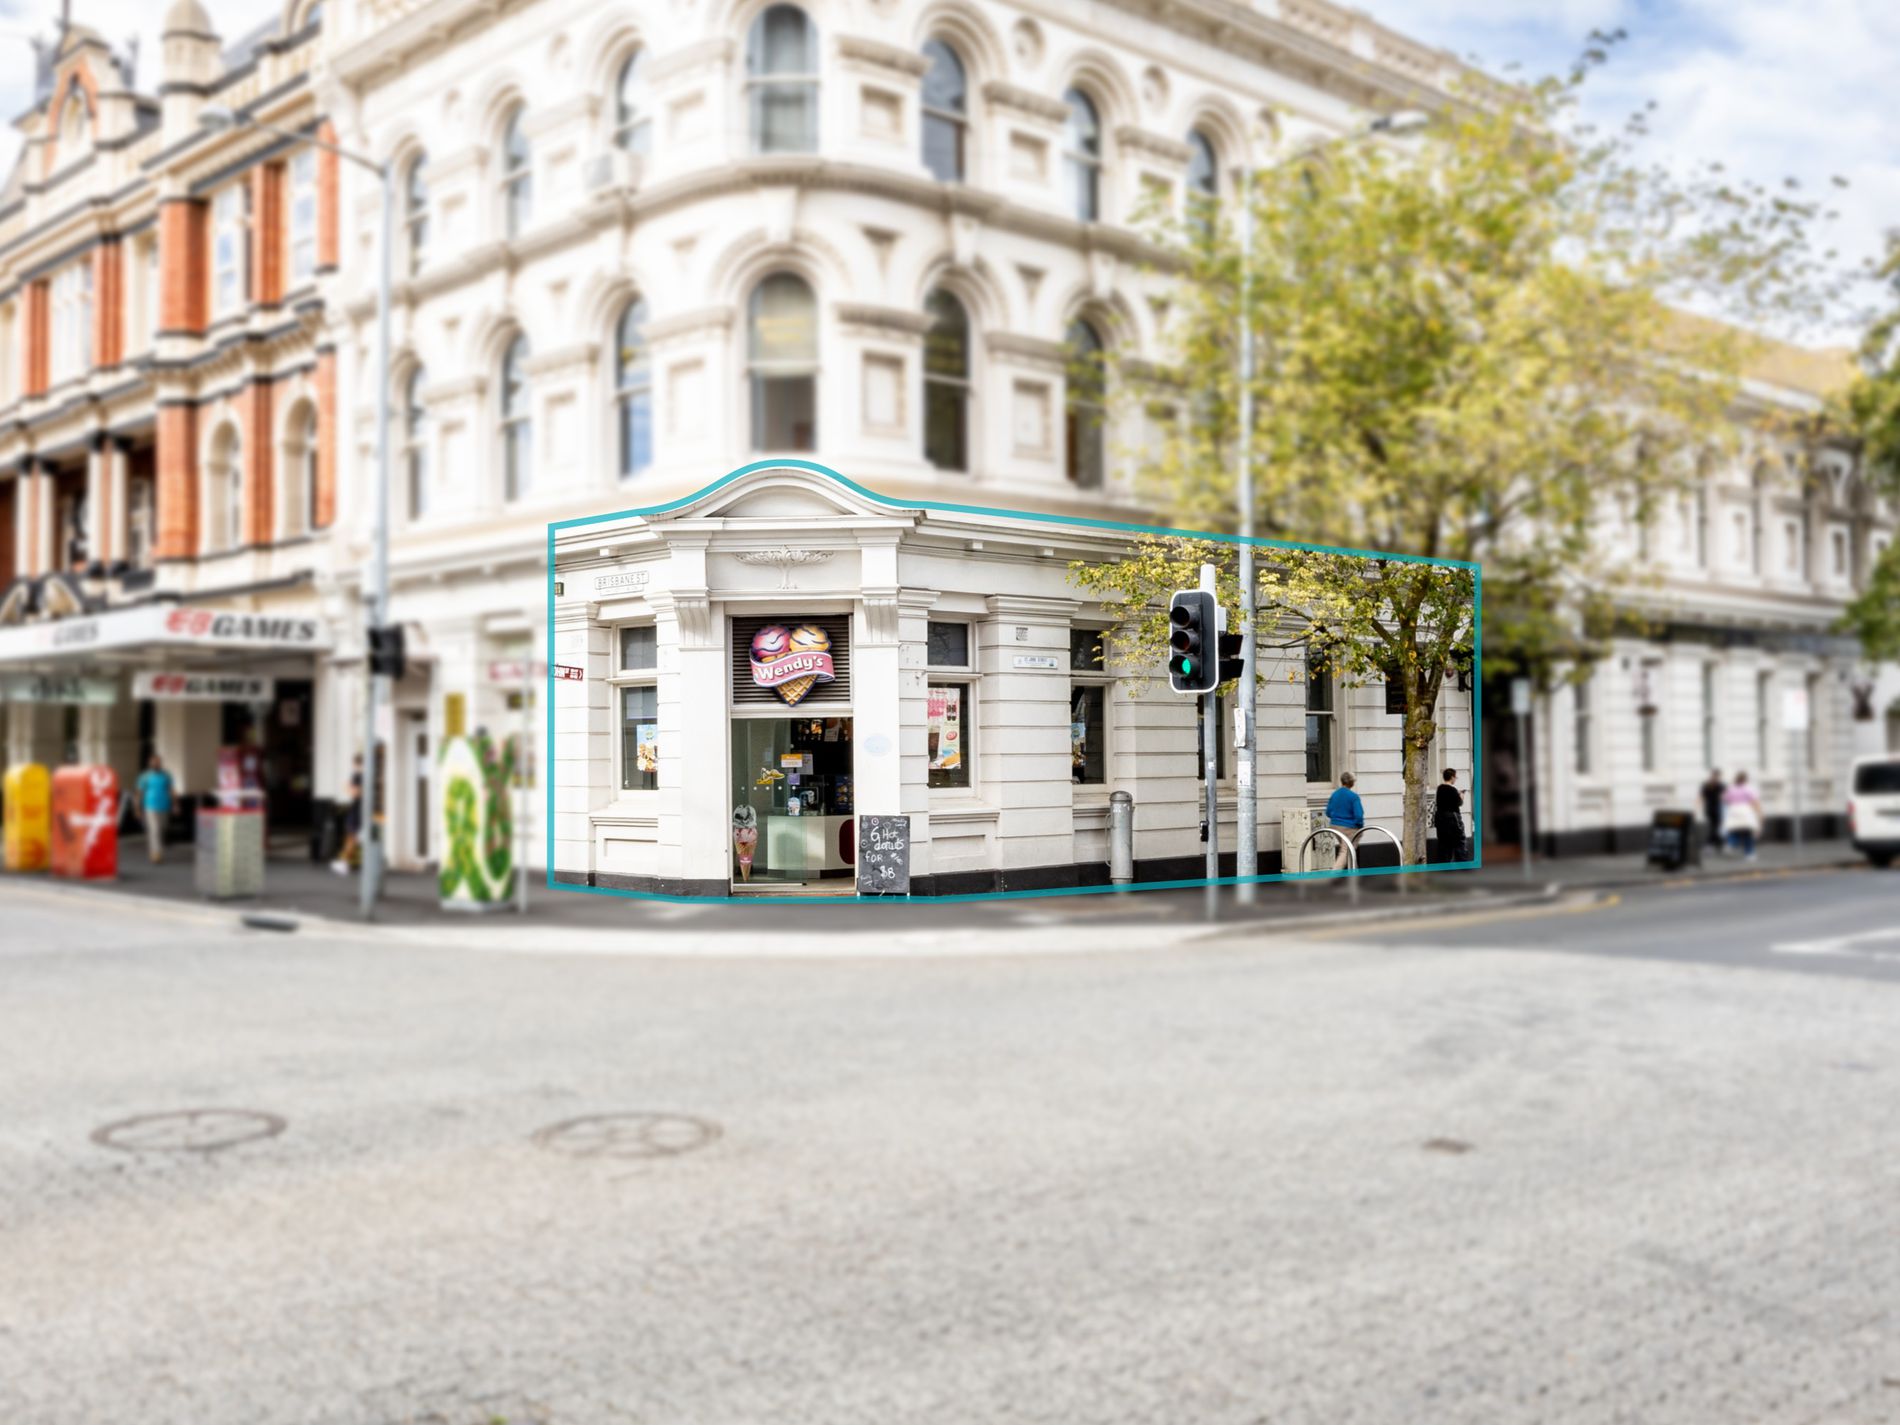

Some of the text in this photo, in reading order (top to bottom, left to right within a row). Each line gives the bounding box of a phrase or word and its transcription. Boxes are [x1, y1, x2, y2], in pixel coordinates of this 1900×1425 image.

[212, 615, 317, 640] GAMES
[757, 656, 823, 680] Wendy's
[186, 676, 263, 695] GAMES
[870, 826, 880, 842] 6
